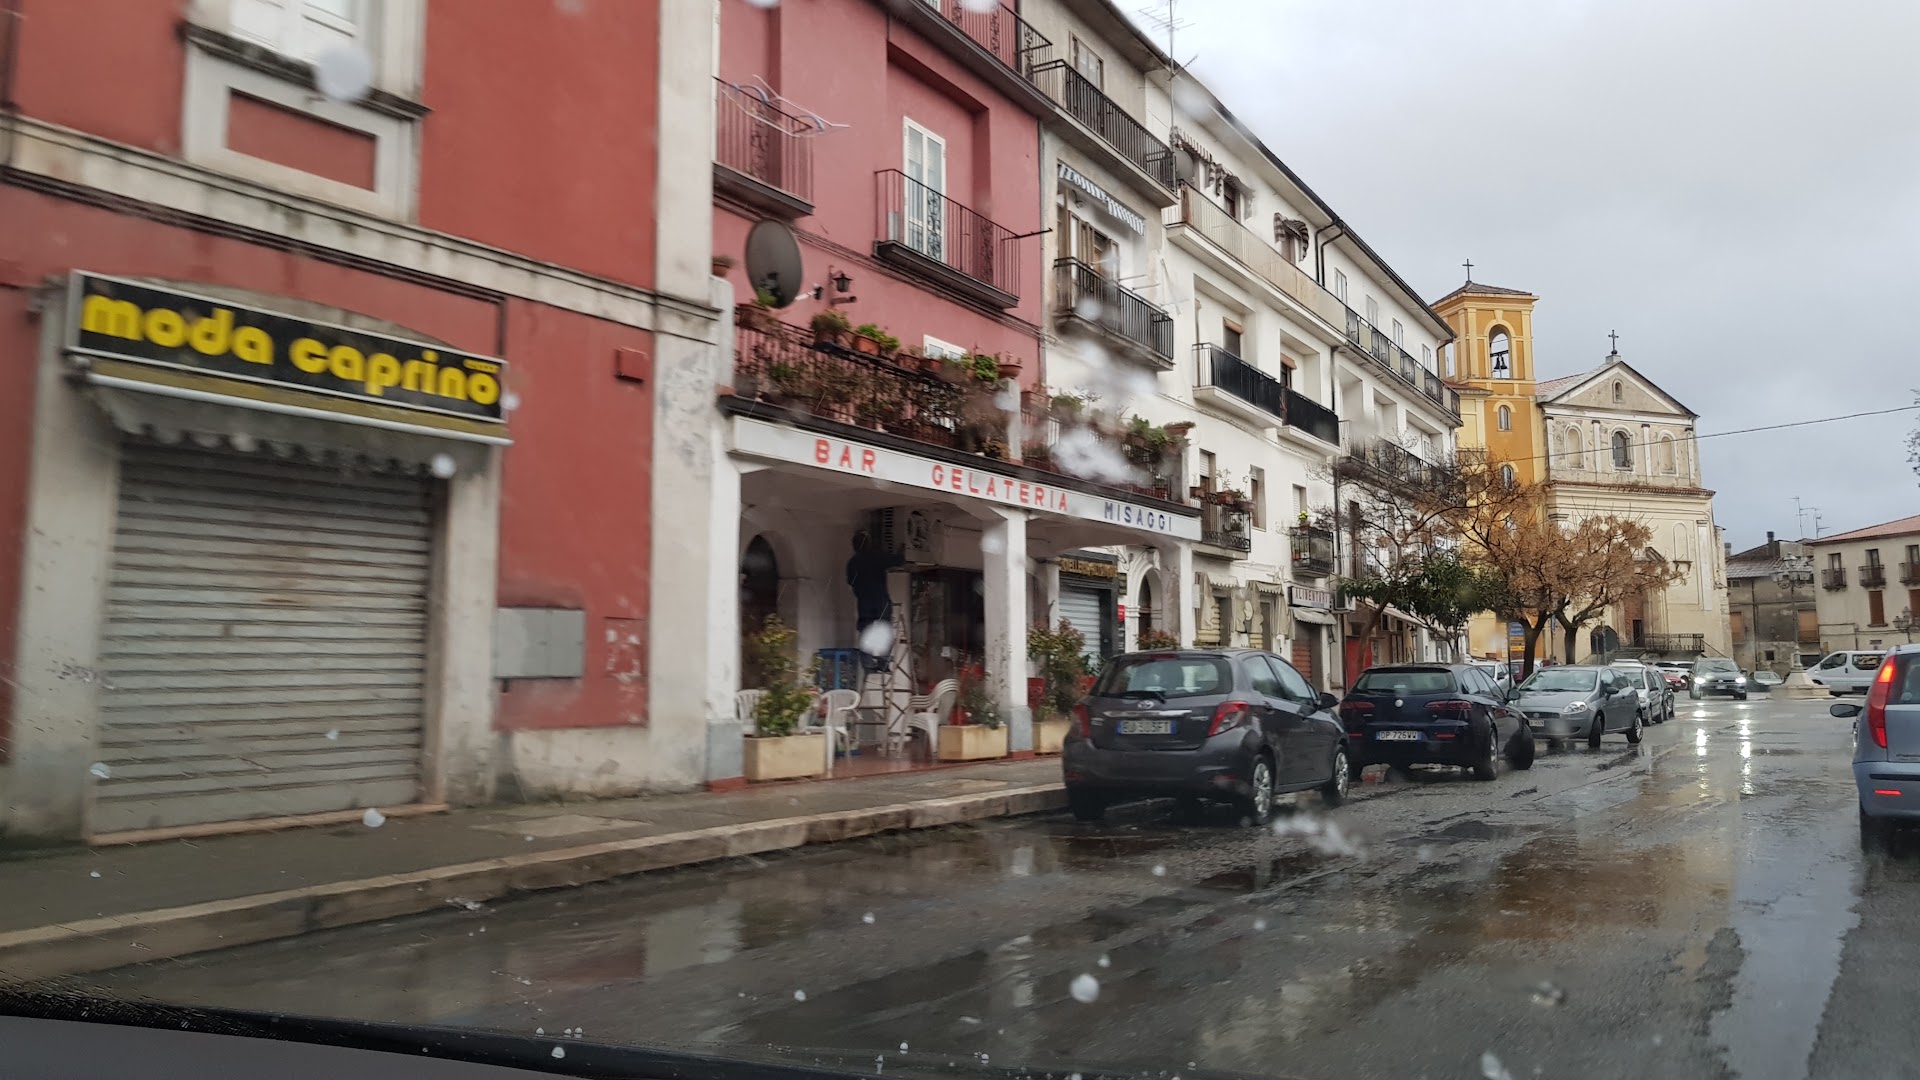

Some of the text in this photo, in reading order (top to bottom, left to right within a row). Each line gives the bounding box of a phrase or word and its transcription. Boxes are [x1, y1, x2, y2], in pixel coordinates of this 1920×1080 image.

[82, 294, 500, 406] moda caprino
[814, 439, 1173, 532] BAR GELATERIA MISAGGI
